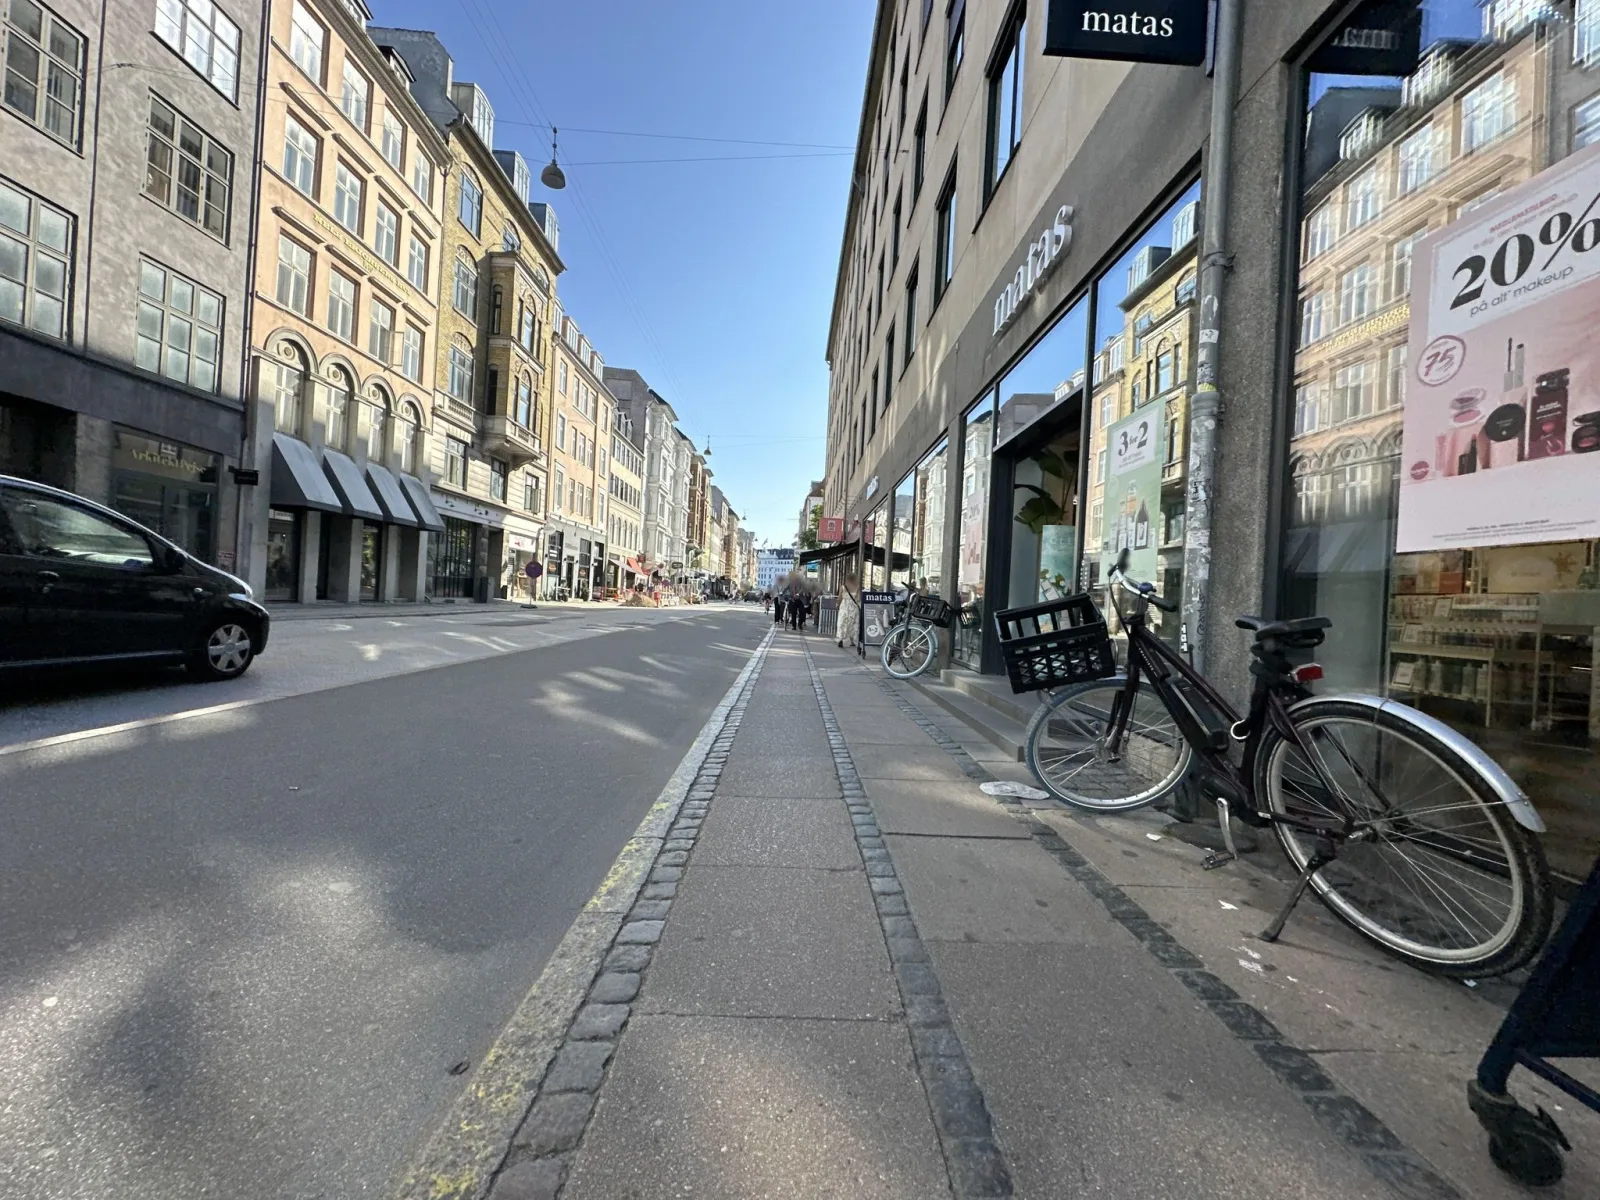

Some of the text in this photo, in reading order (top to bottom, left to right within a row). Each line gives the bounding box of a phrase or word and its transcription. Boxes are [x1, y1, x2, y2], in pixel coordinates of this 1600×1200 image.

[1081, 11, 1173, 37] matas
[993, 205, 1074, 336] matas
[1450, 192, 1600, 310] 20%
[1470, 304, 1488, 317] på
[1513, 266, 1574, 298] makeup
[1118, 431, 1129, 456] 3
[1137, 421, 1148, 449] 2
[865, 594, 893, 602] matas
